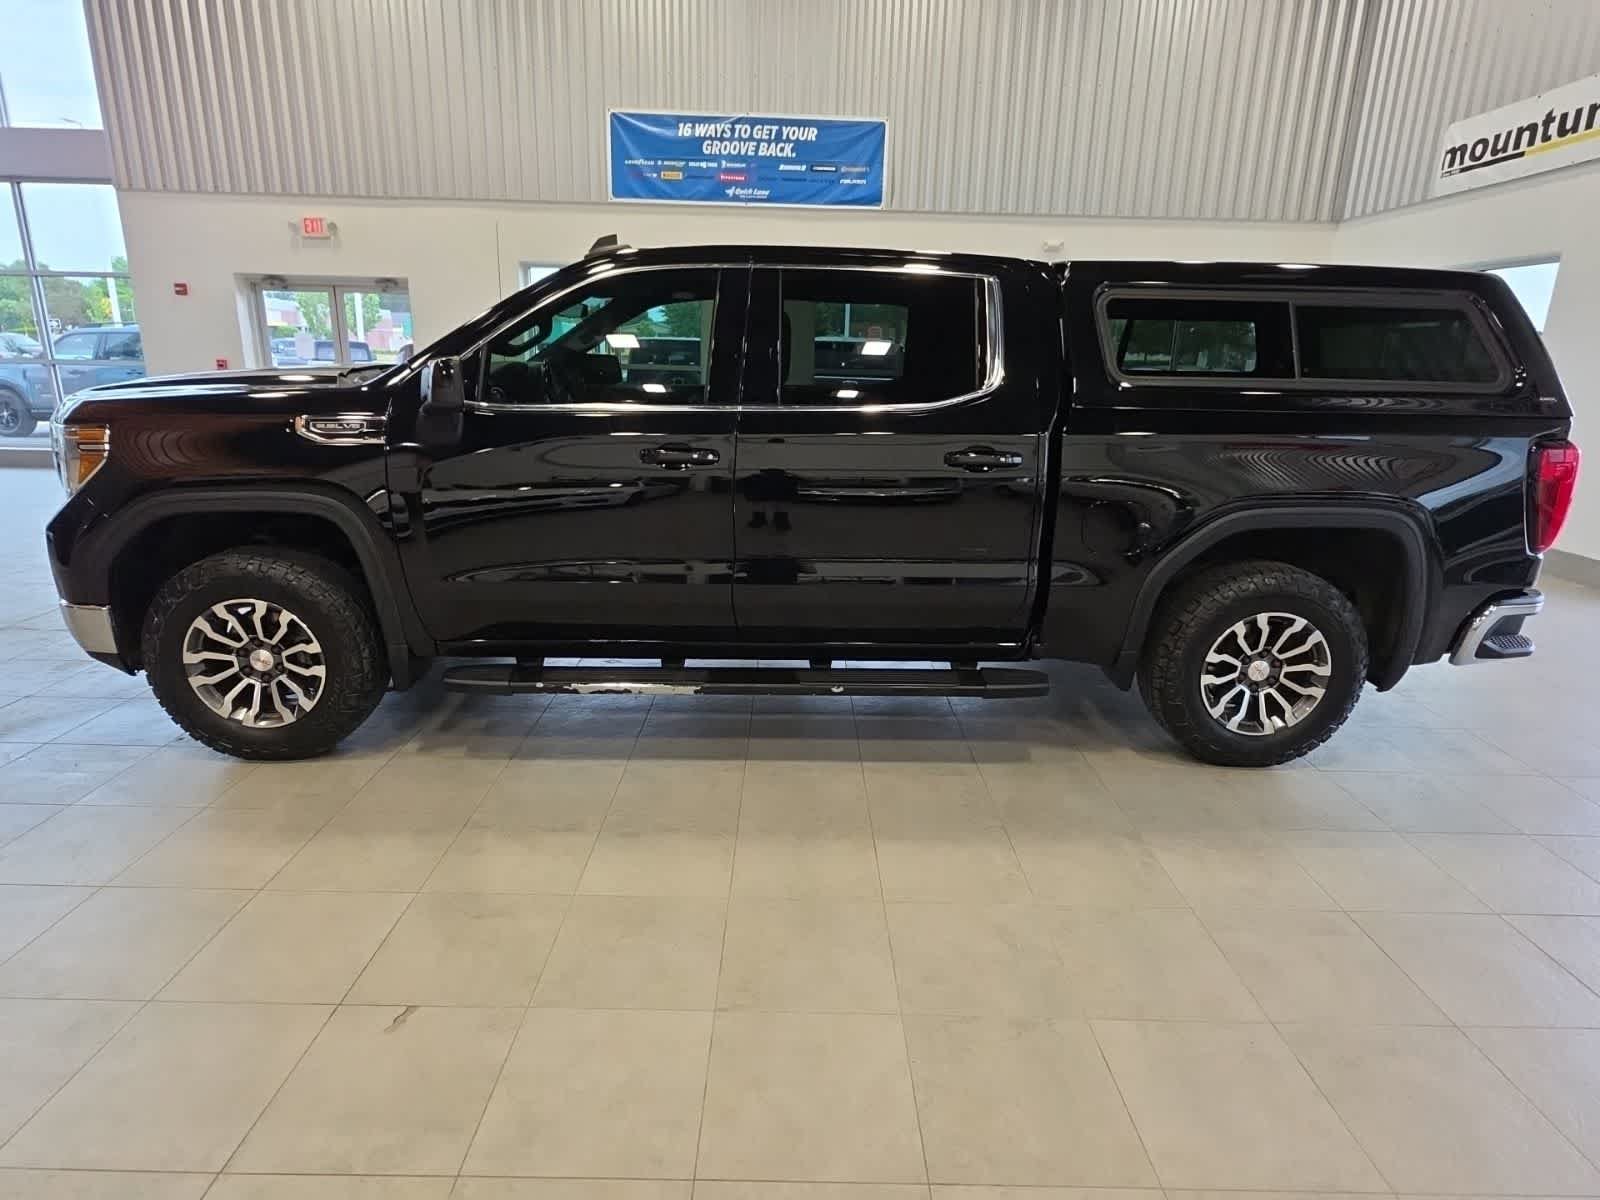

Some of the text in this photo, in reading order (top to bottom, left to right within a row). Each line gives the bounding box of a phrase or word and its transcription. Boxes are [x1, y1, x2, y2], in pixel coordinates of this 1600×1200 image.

[677, 122, 818, 142] 16 WAYS TO GET YOUR
[702, 141, 796, 158] GROOVE BACK.
[303, 217, 325, 233] EXIT
